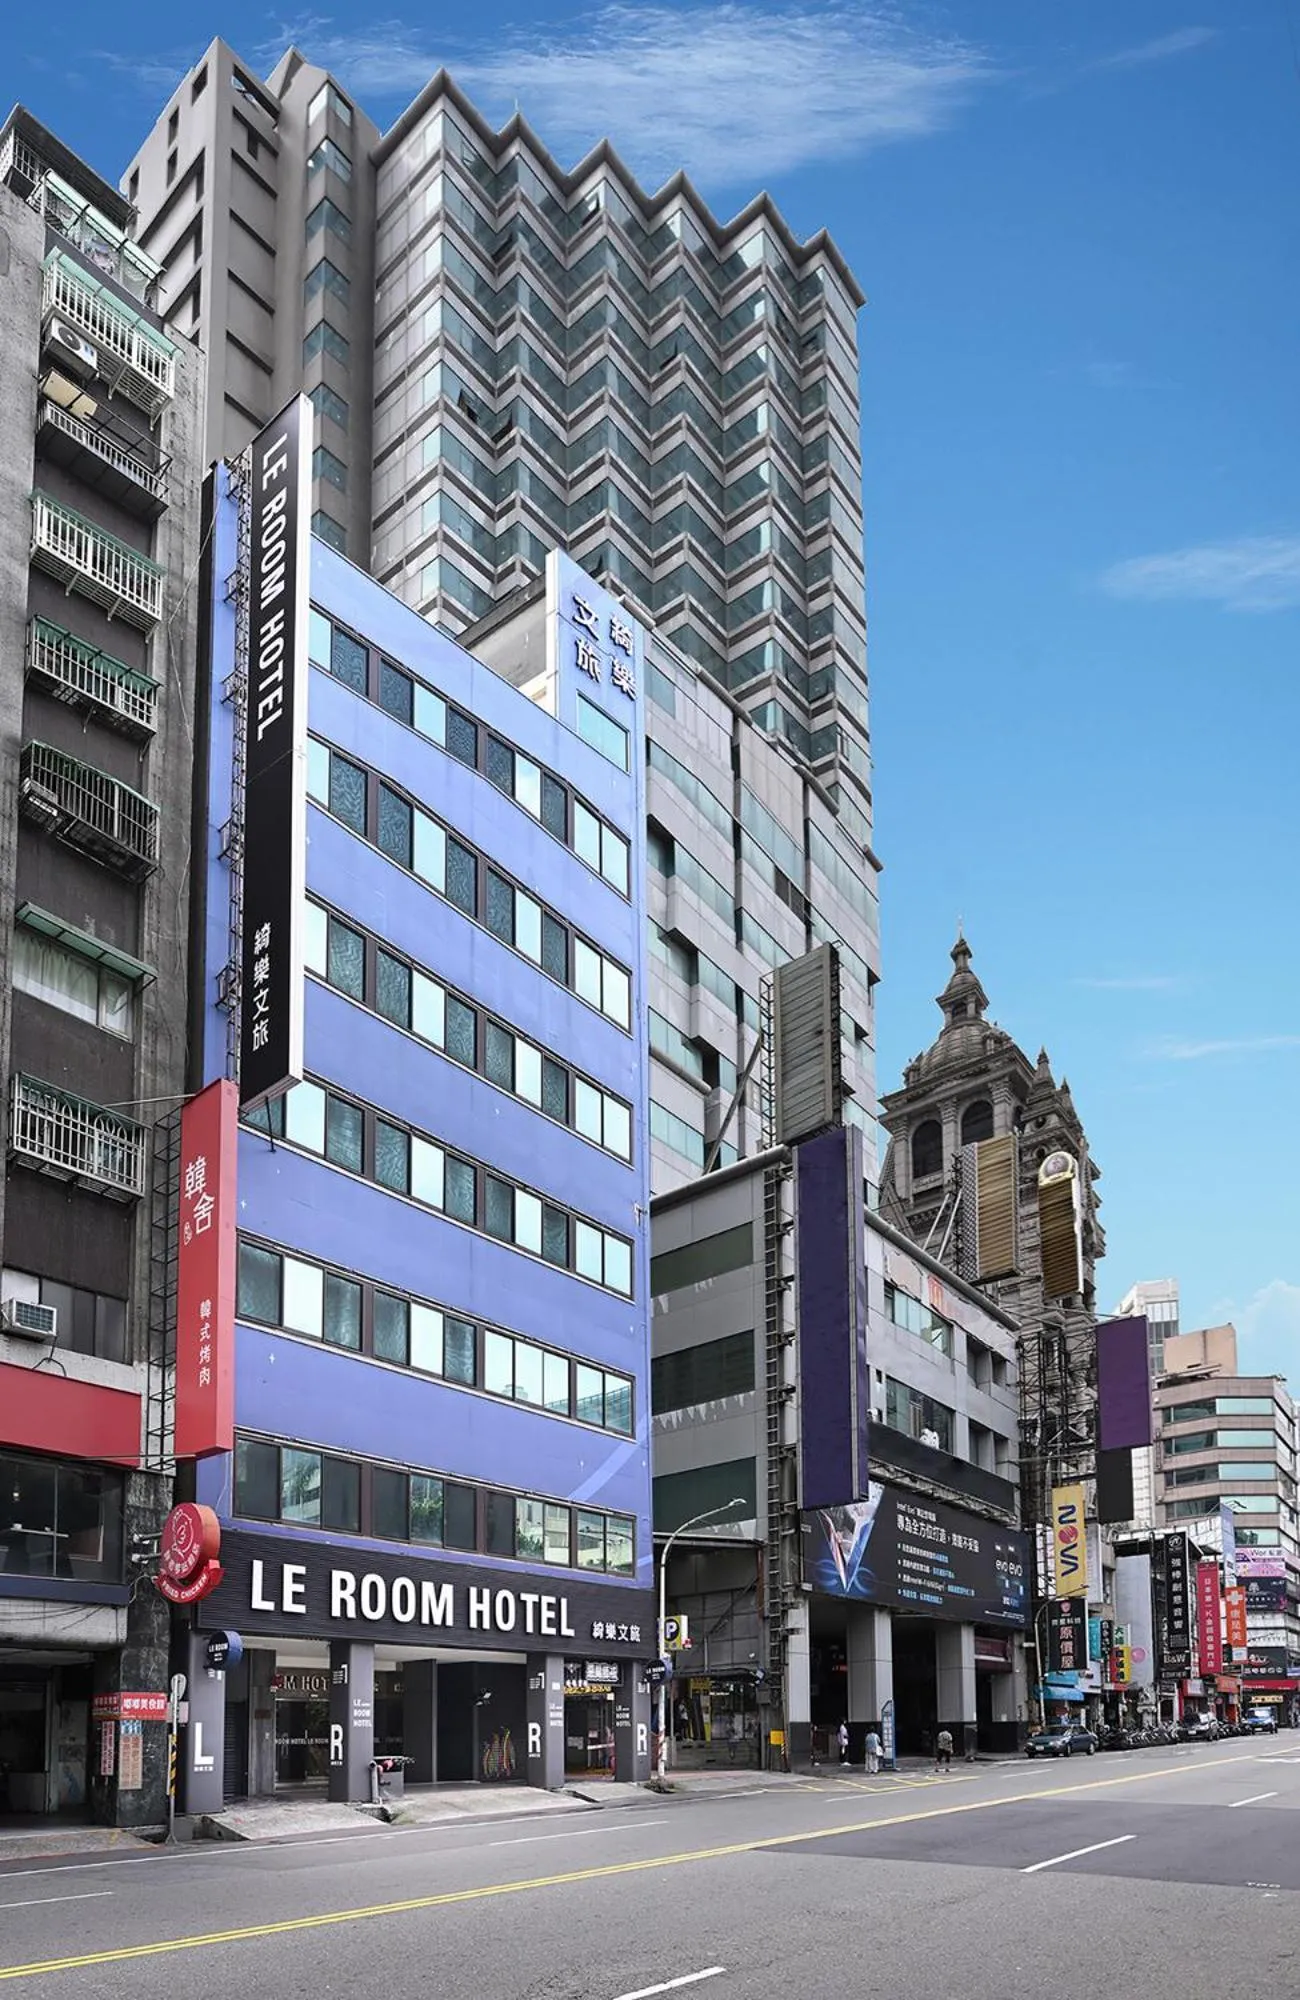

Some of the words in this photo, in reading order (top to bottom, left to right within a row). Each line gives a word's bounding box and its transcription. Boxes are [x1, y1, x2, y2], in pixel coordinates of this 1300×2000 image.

[260, 434, 289, 493] LE
[260, 493, 288, 611] ROOM
[256, 615, 286, 742] HOTEL
[250, 921, 272, 1053] 綺樂文旅
[184, 1155, 215, 1236] 韓舍
[198, 1299, 213, 1388] 韓式烤肉
[1008, 1559, 1023, 1577] evo
[251, 1559, 307, 1614] LE
[331, 1569, 454, 1627] ROOM
[469, 1586, 576, 1637] HOTEL
[592, 1620, 641, 1643] 綺樂文旅
[215, 1642, 229, 1651] ROOM
[666, 1621, 678, 1639] P
[194, 1722, 214, 1765] L
[330, 1724, 344, 1761] R
[353, 1719, 372, 1728] HOTEL
[528, 1722, 541, 1753] R
[637, 1723, 647, 1753] R
